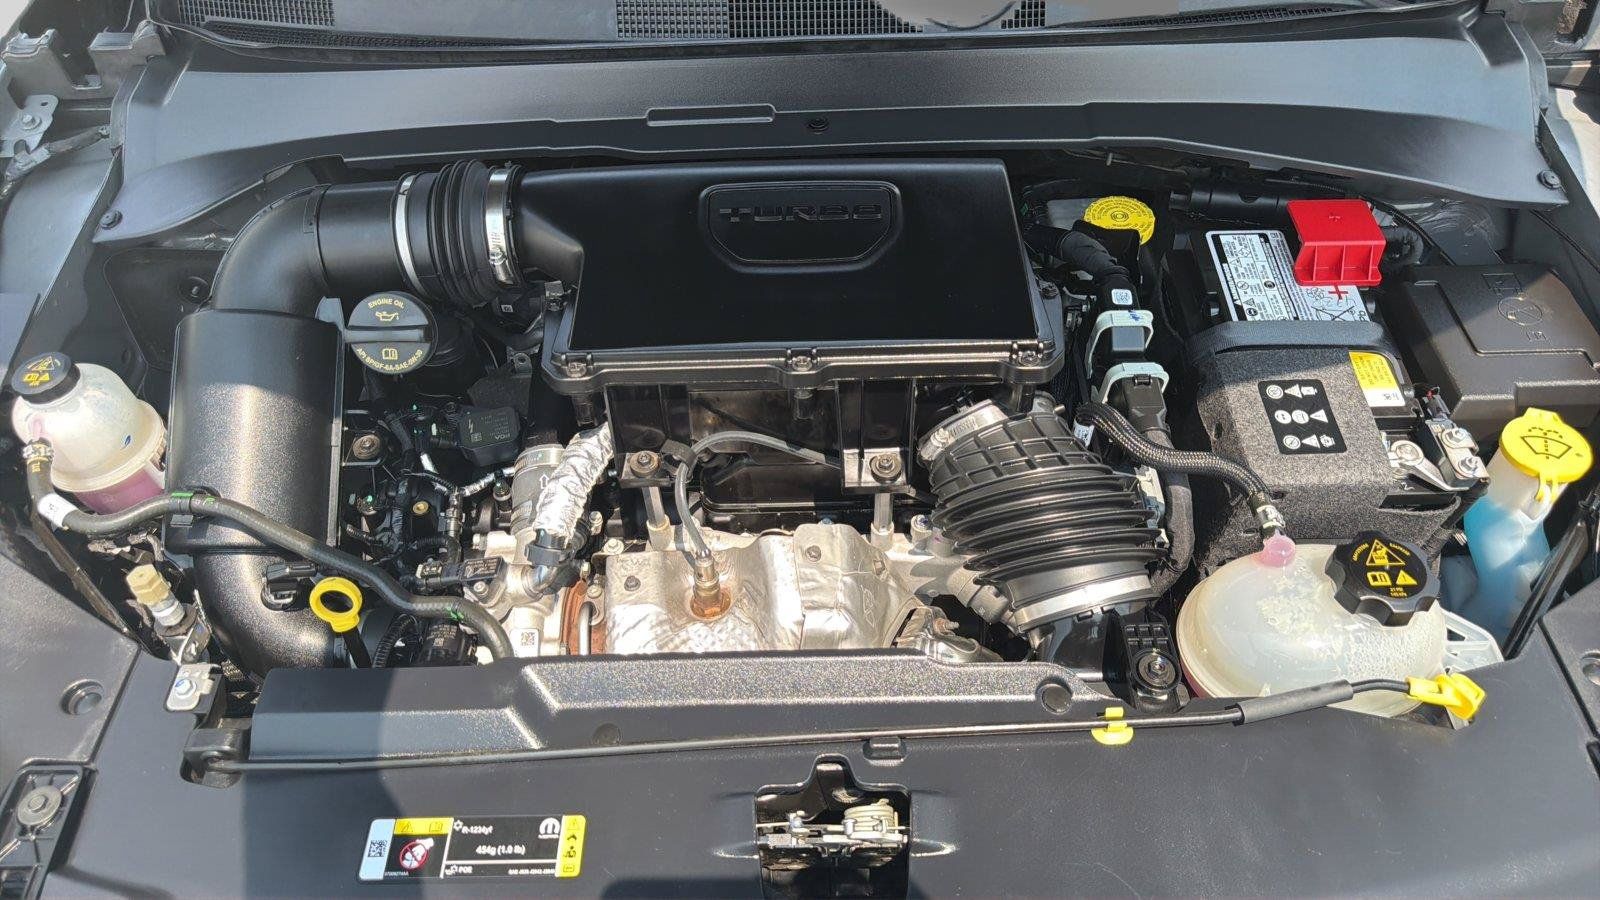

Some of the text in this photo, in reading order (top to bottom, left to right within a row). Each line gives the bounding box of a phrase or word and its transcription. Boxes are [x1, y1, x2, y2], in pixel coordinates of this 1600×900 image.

[719, 204, 882, 222] TURBO
[368, 298, 405, 309] ENGINE OIL
[476, 845, 496, 856] 454g
